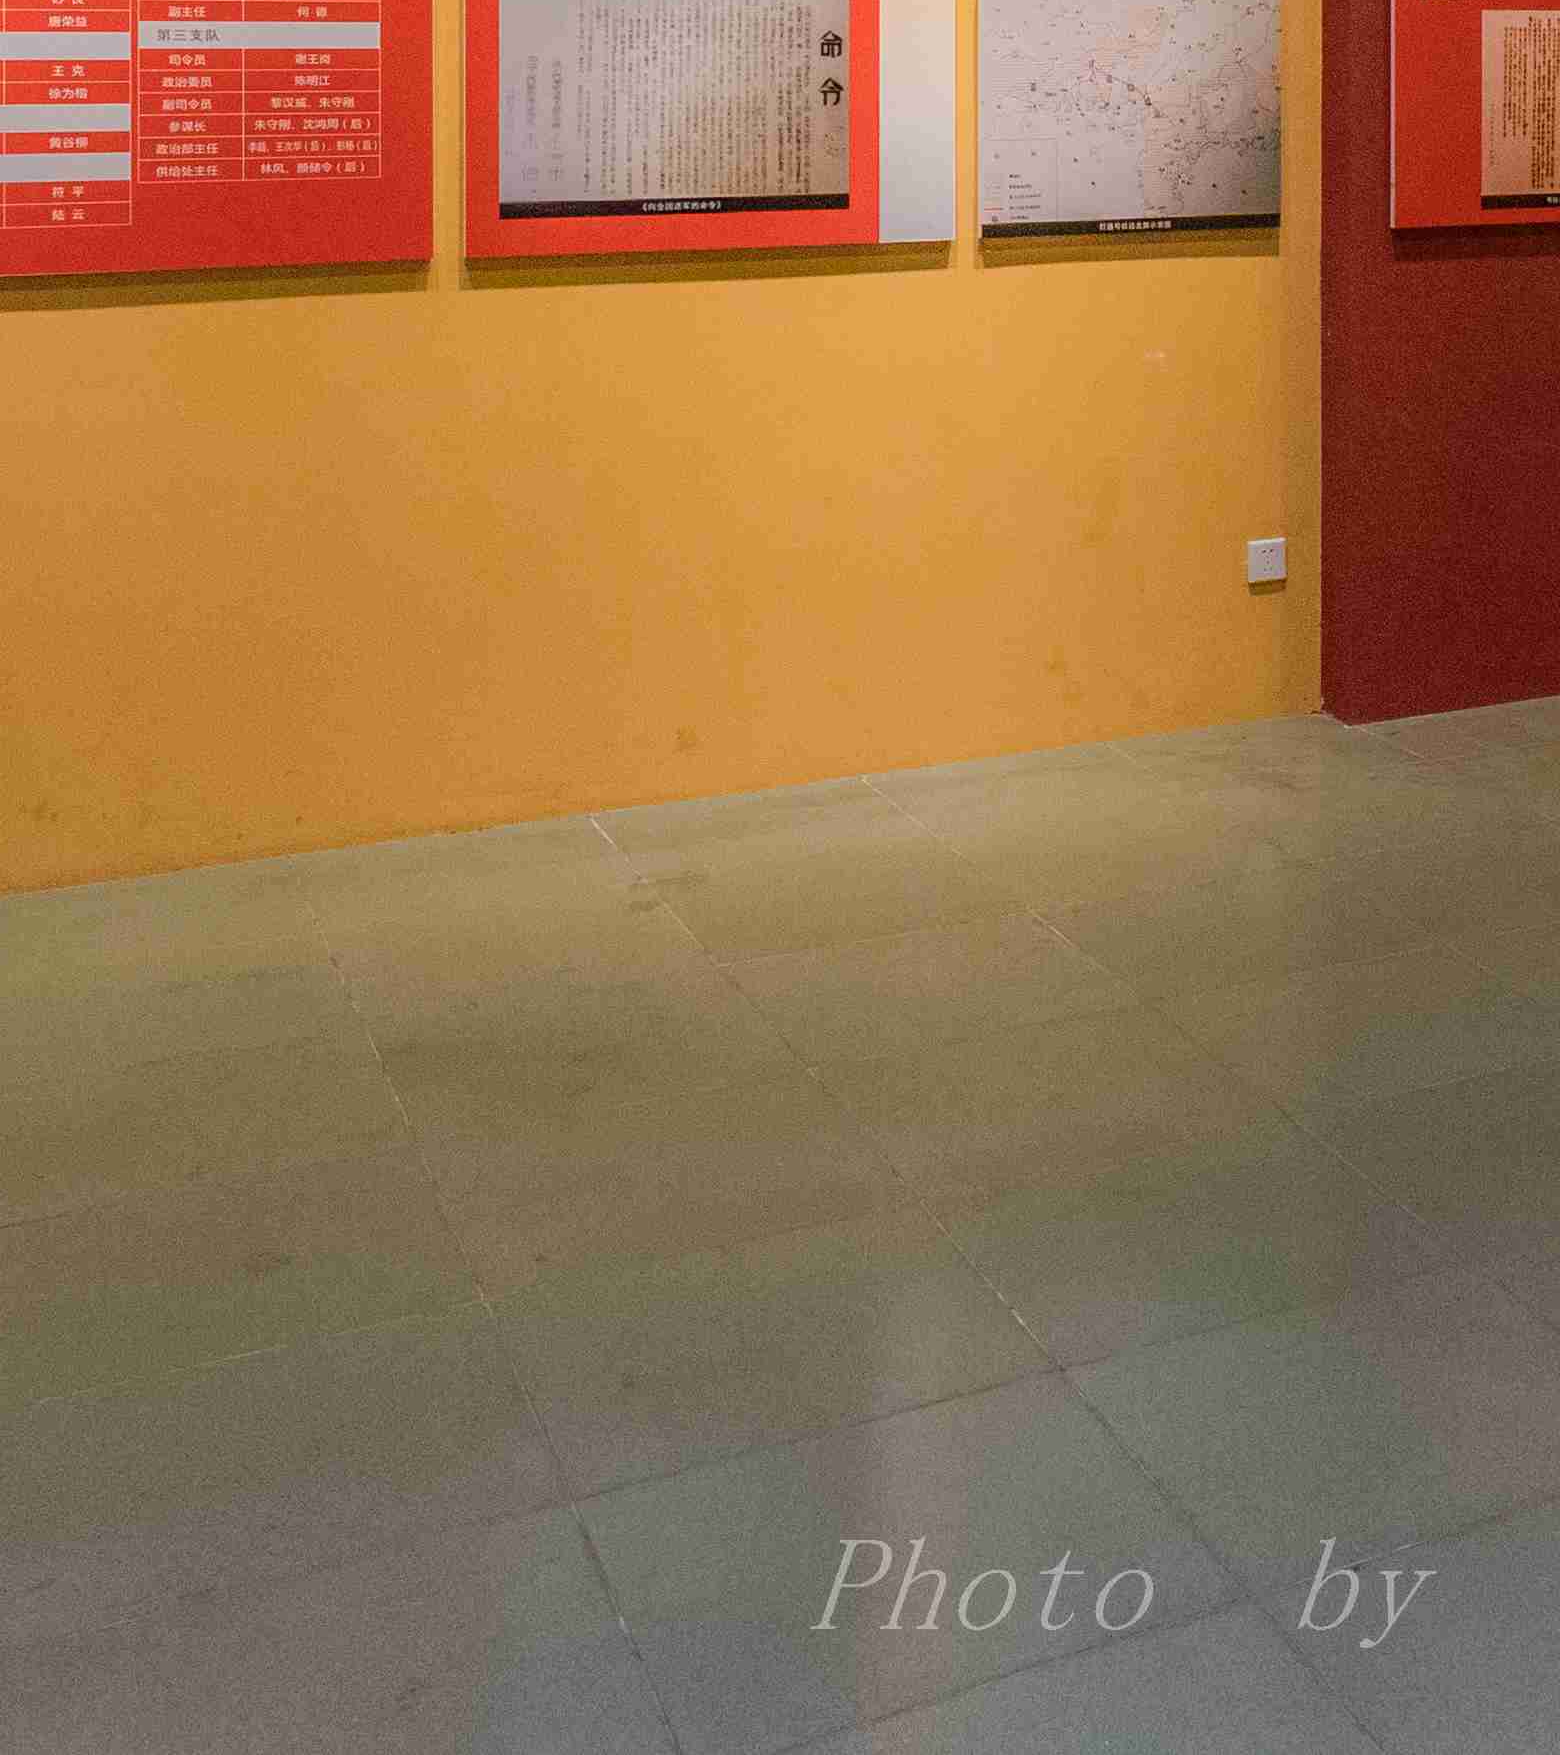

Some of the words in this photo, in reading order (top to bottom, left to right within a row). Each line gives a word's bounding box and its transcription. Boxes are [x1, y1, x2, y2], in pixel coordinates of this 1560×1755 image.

[157, 29, 220, 41] 第三支队
[819, 29, 844, 108] 命令
[162, 76, 211, 88] 政治委员
[156, 142, 217, 155] 政治部主任
